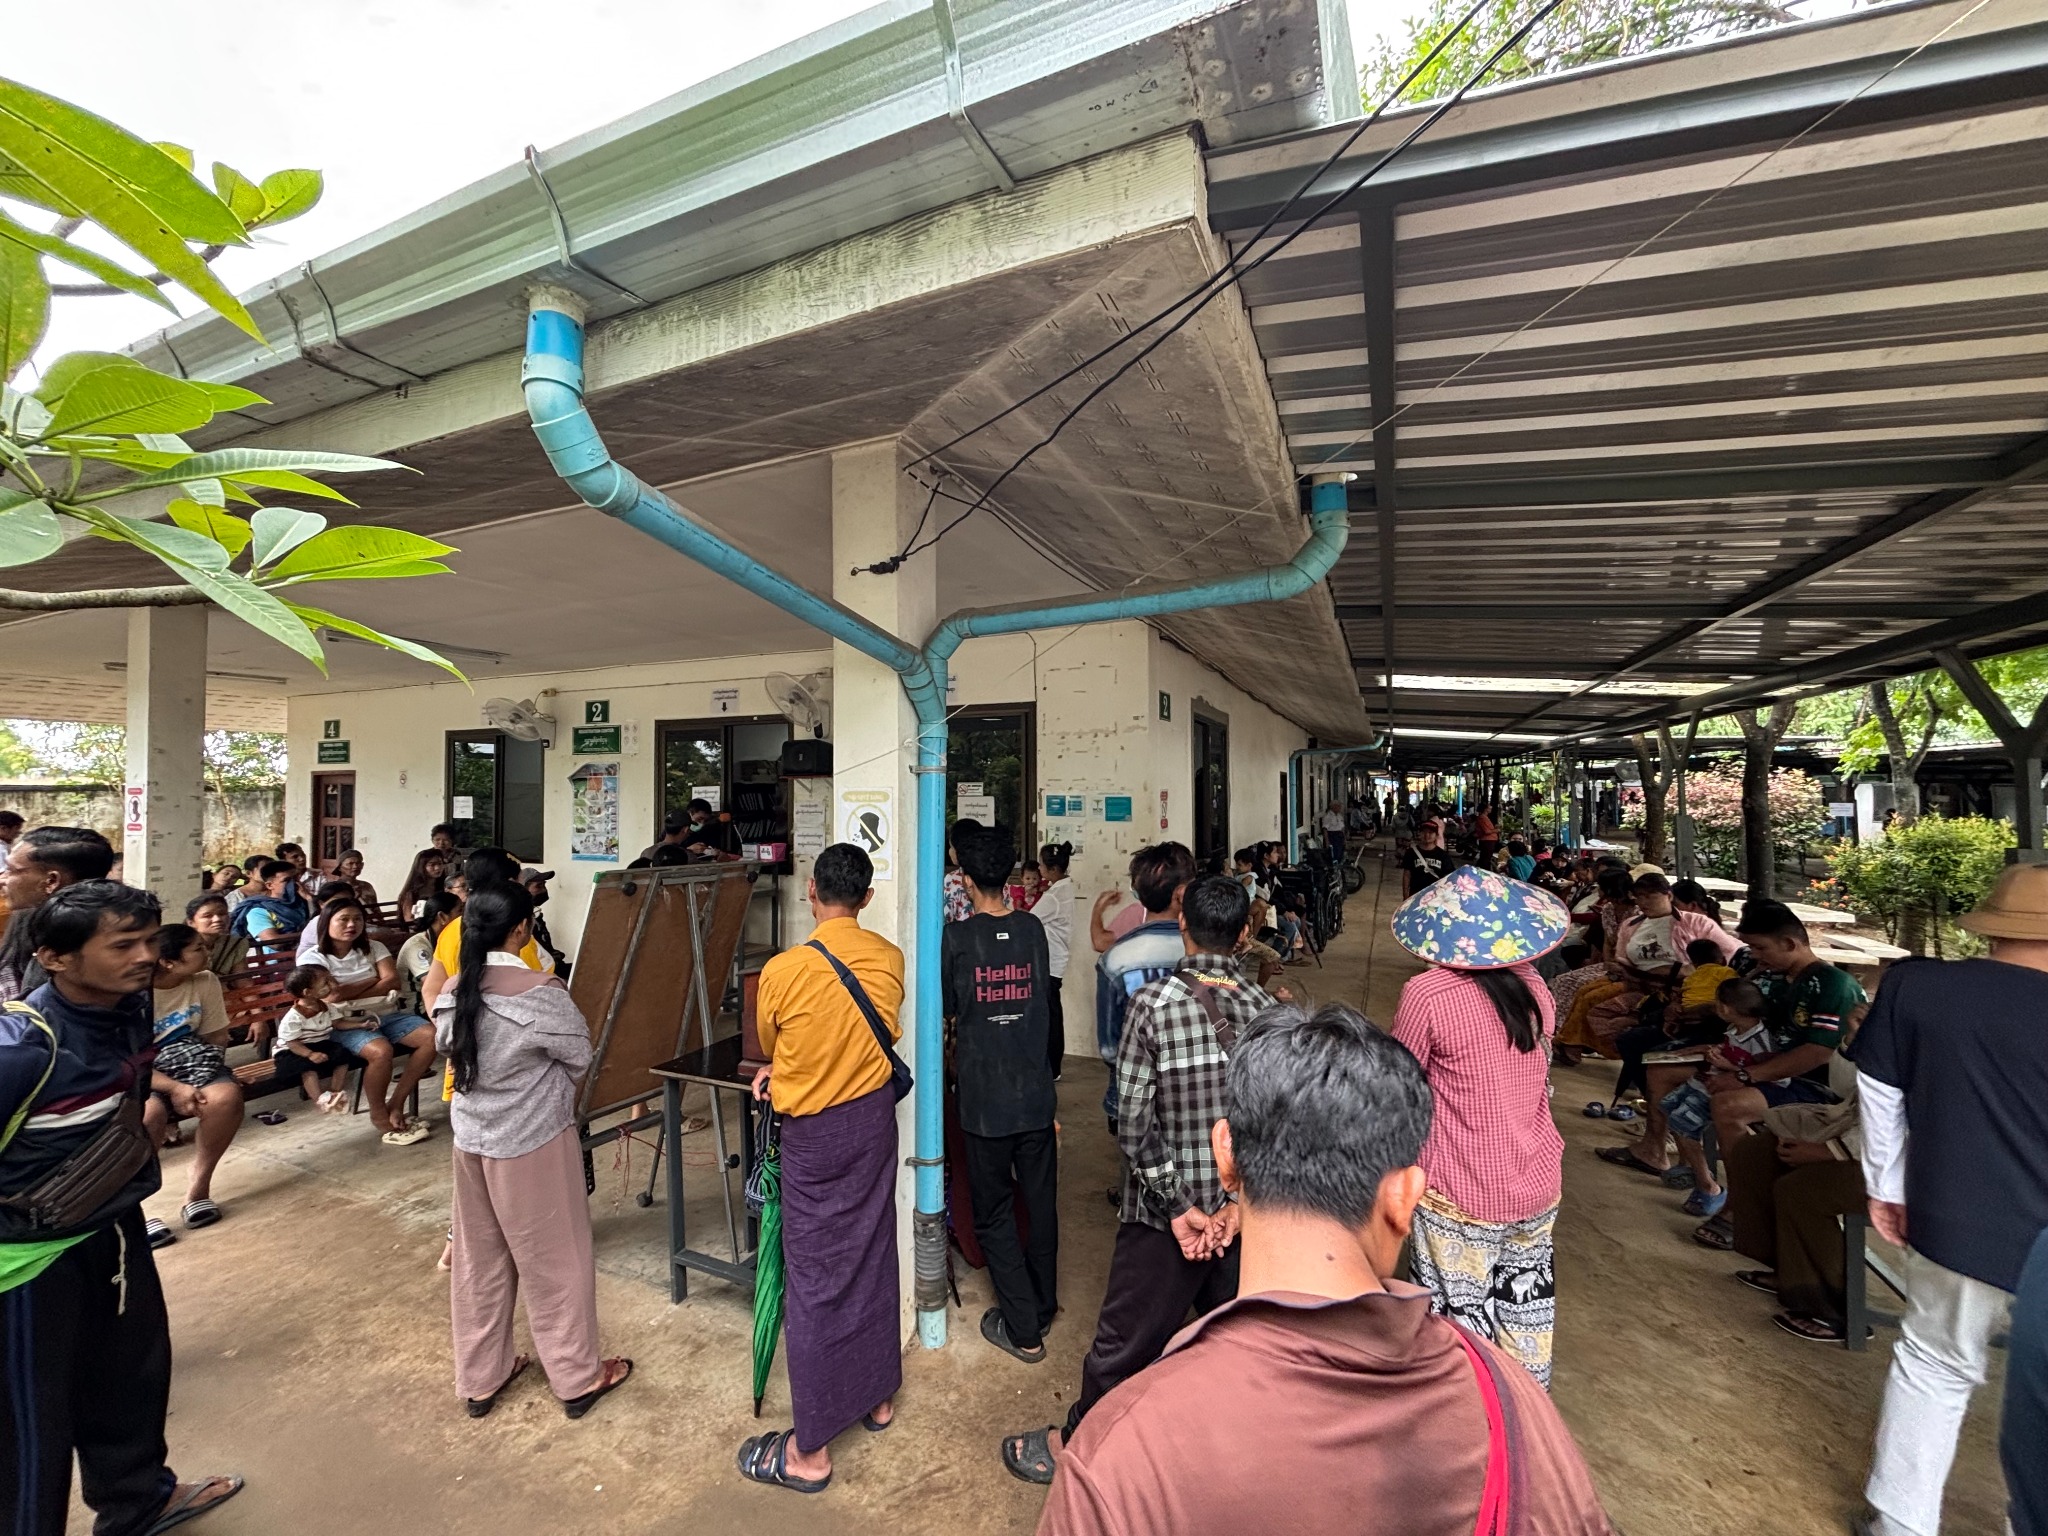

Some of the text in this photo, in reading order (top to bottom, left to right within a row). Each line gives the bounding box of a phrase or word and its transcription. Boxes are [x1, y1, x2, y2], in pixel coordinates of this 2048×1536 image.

[592, 702, 602, 721] 2
[1163, 695, 1168, 716] 2
[327, 721, 336, 737] 4
[975, 963, 1031, 982] Hello!
[976, 982, 1032, 1002] Hello!
